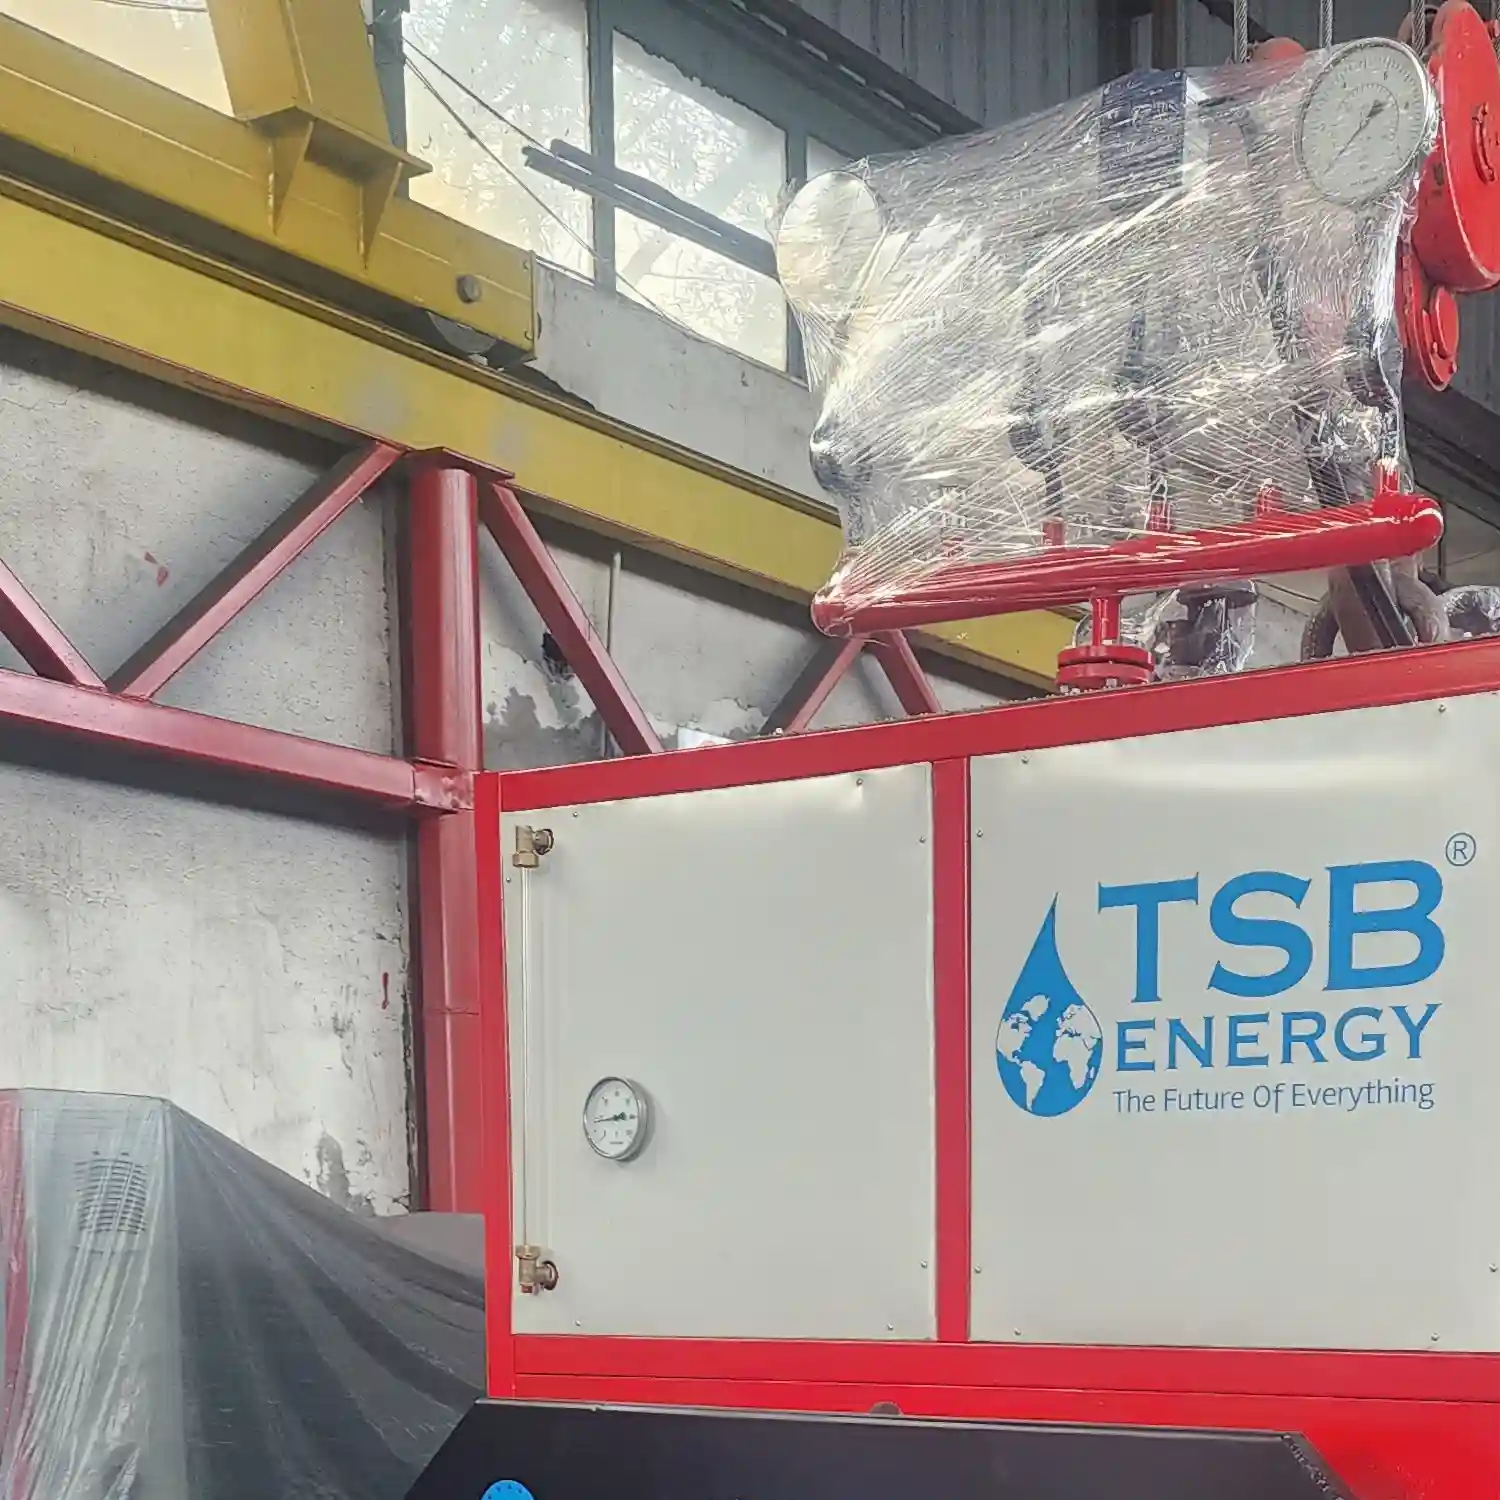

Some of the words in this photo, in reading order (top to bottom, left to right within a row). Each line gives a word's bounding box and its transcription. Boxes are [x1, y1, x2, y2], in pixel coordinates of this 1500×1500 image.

[1098, 859, 1446, 1003] TSB
[1115, 1003, 1443, 1072] ENERGY
[1112, 1088, 1156, 1113] The
[1163, 1087, 1245, 1112] Future
[1253, 1082, 1286, 1114] Of
[1292, 1077, 1436, 1113] Everything
